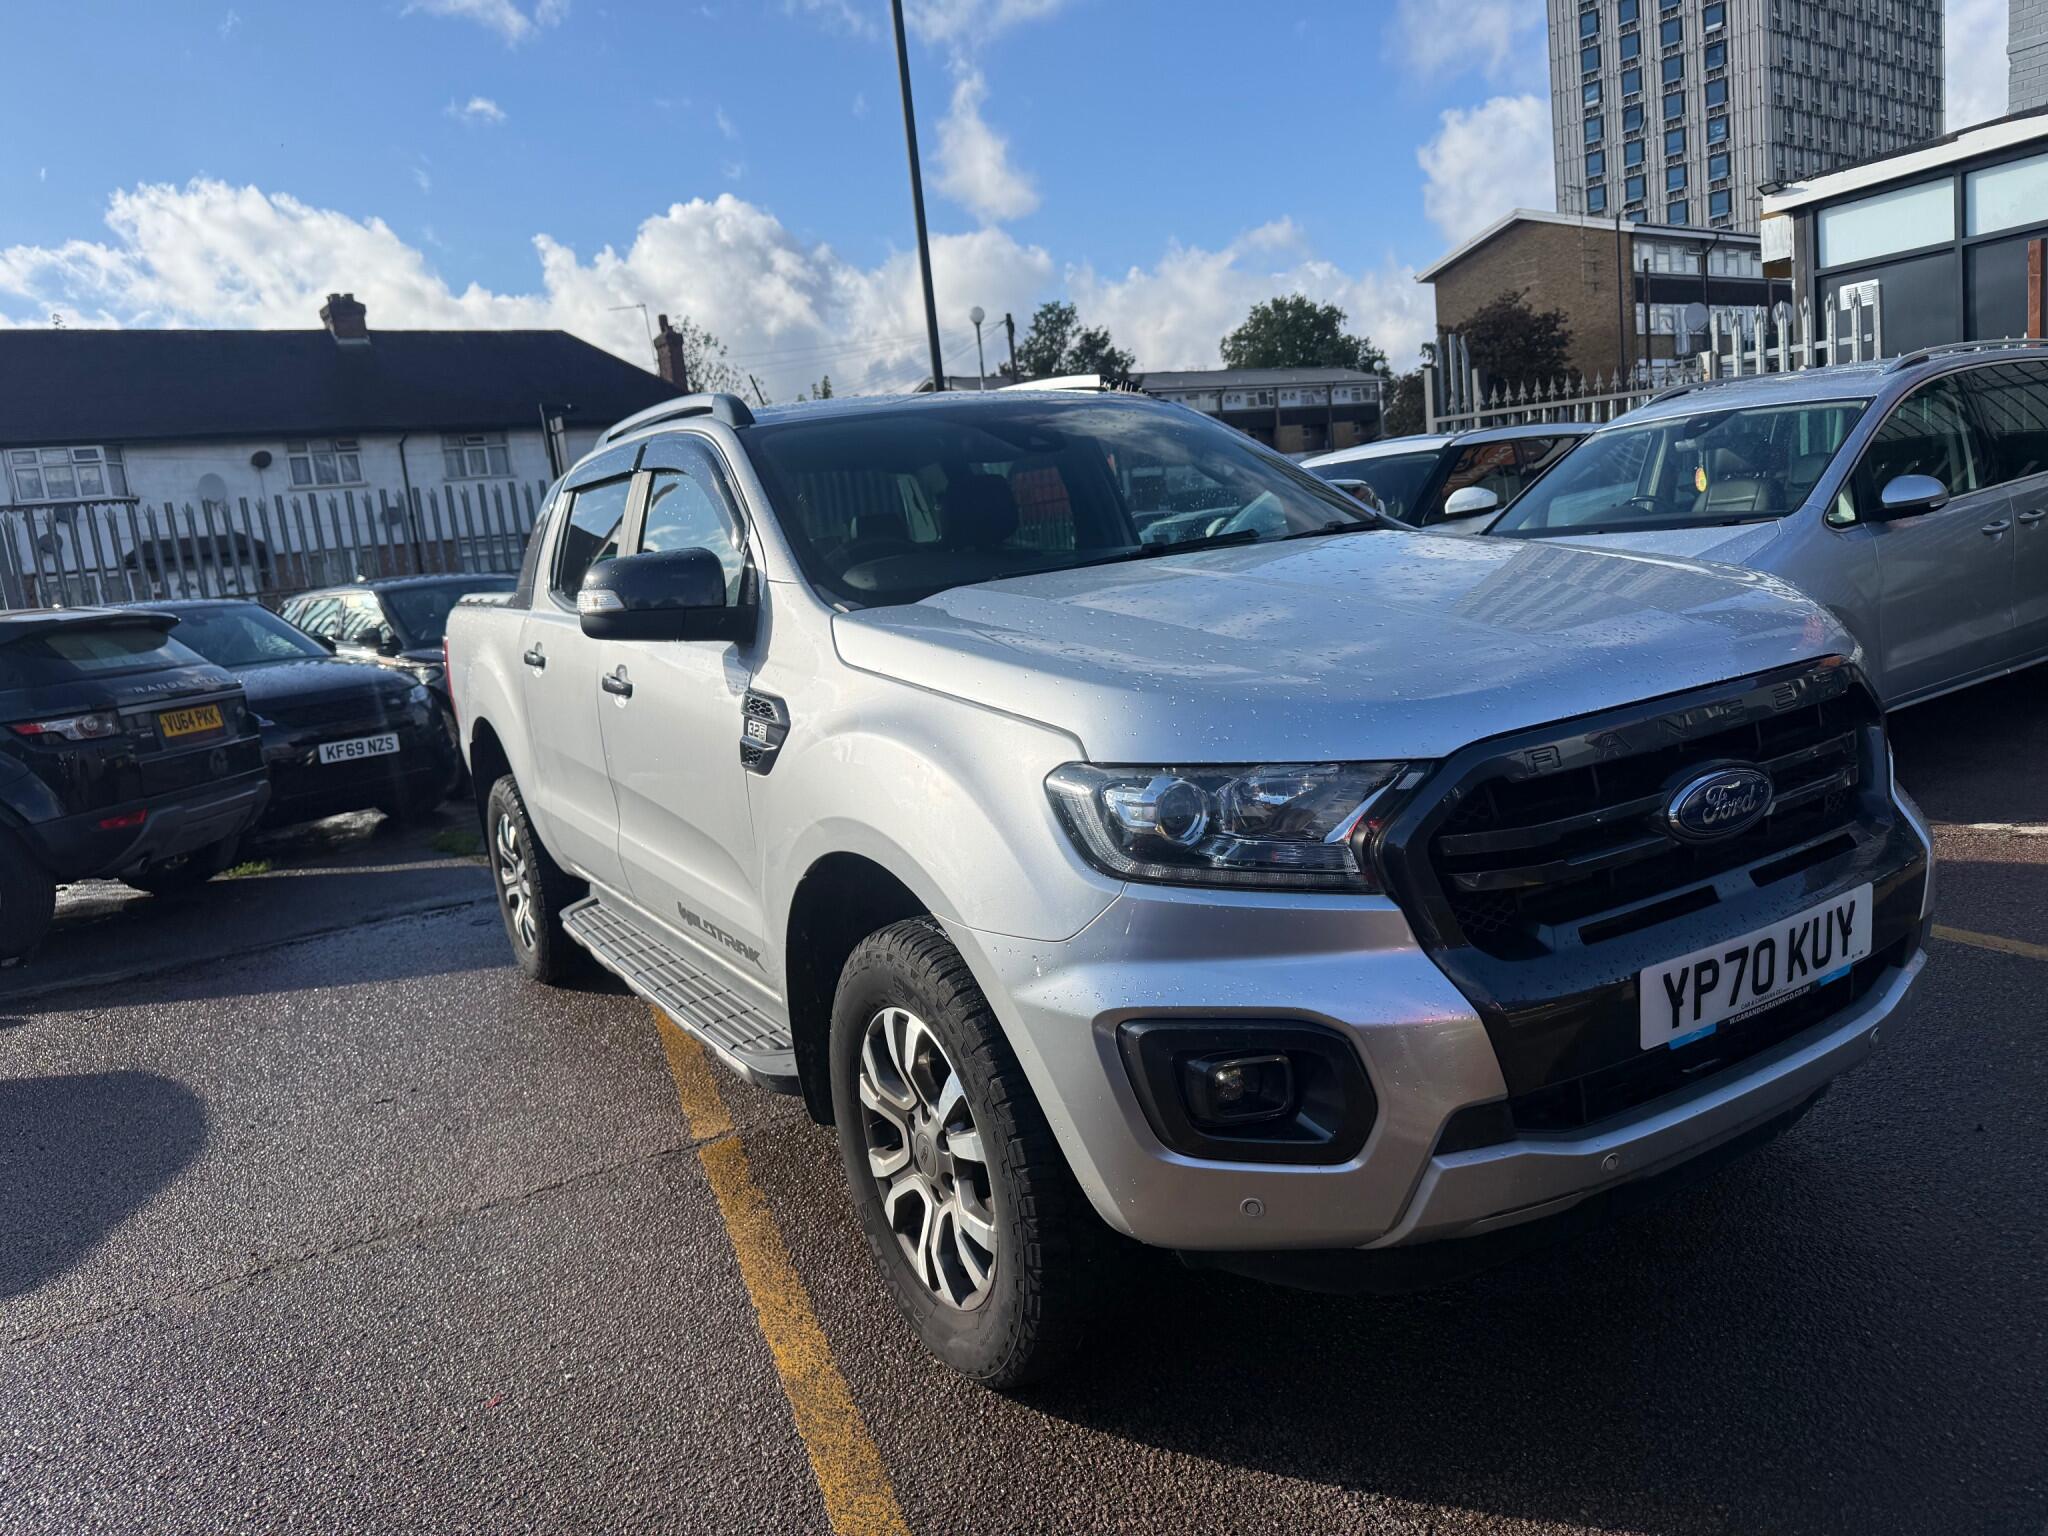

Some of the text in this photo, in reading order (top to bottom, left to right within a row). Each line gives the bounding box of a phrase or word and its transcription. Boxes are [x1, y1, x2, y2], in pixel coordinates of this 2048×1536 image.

[195, 706, 218, 728] PKK
[325, 737, 395, 760] KF69 NZS
[1702, 780, 1757, 824] Ford
[677, 901, 767, 973] WILDTRAK
[1663, 900, 1856, 1029] YP70 KUY
